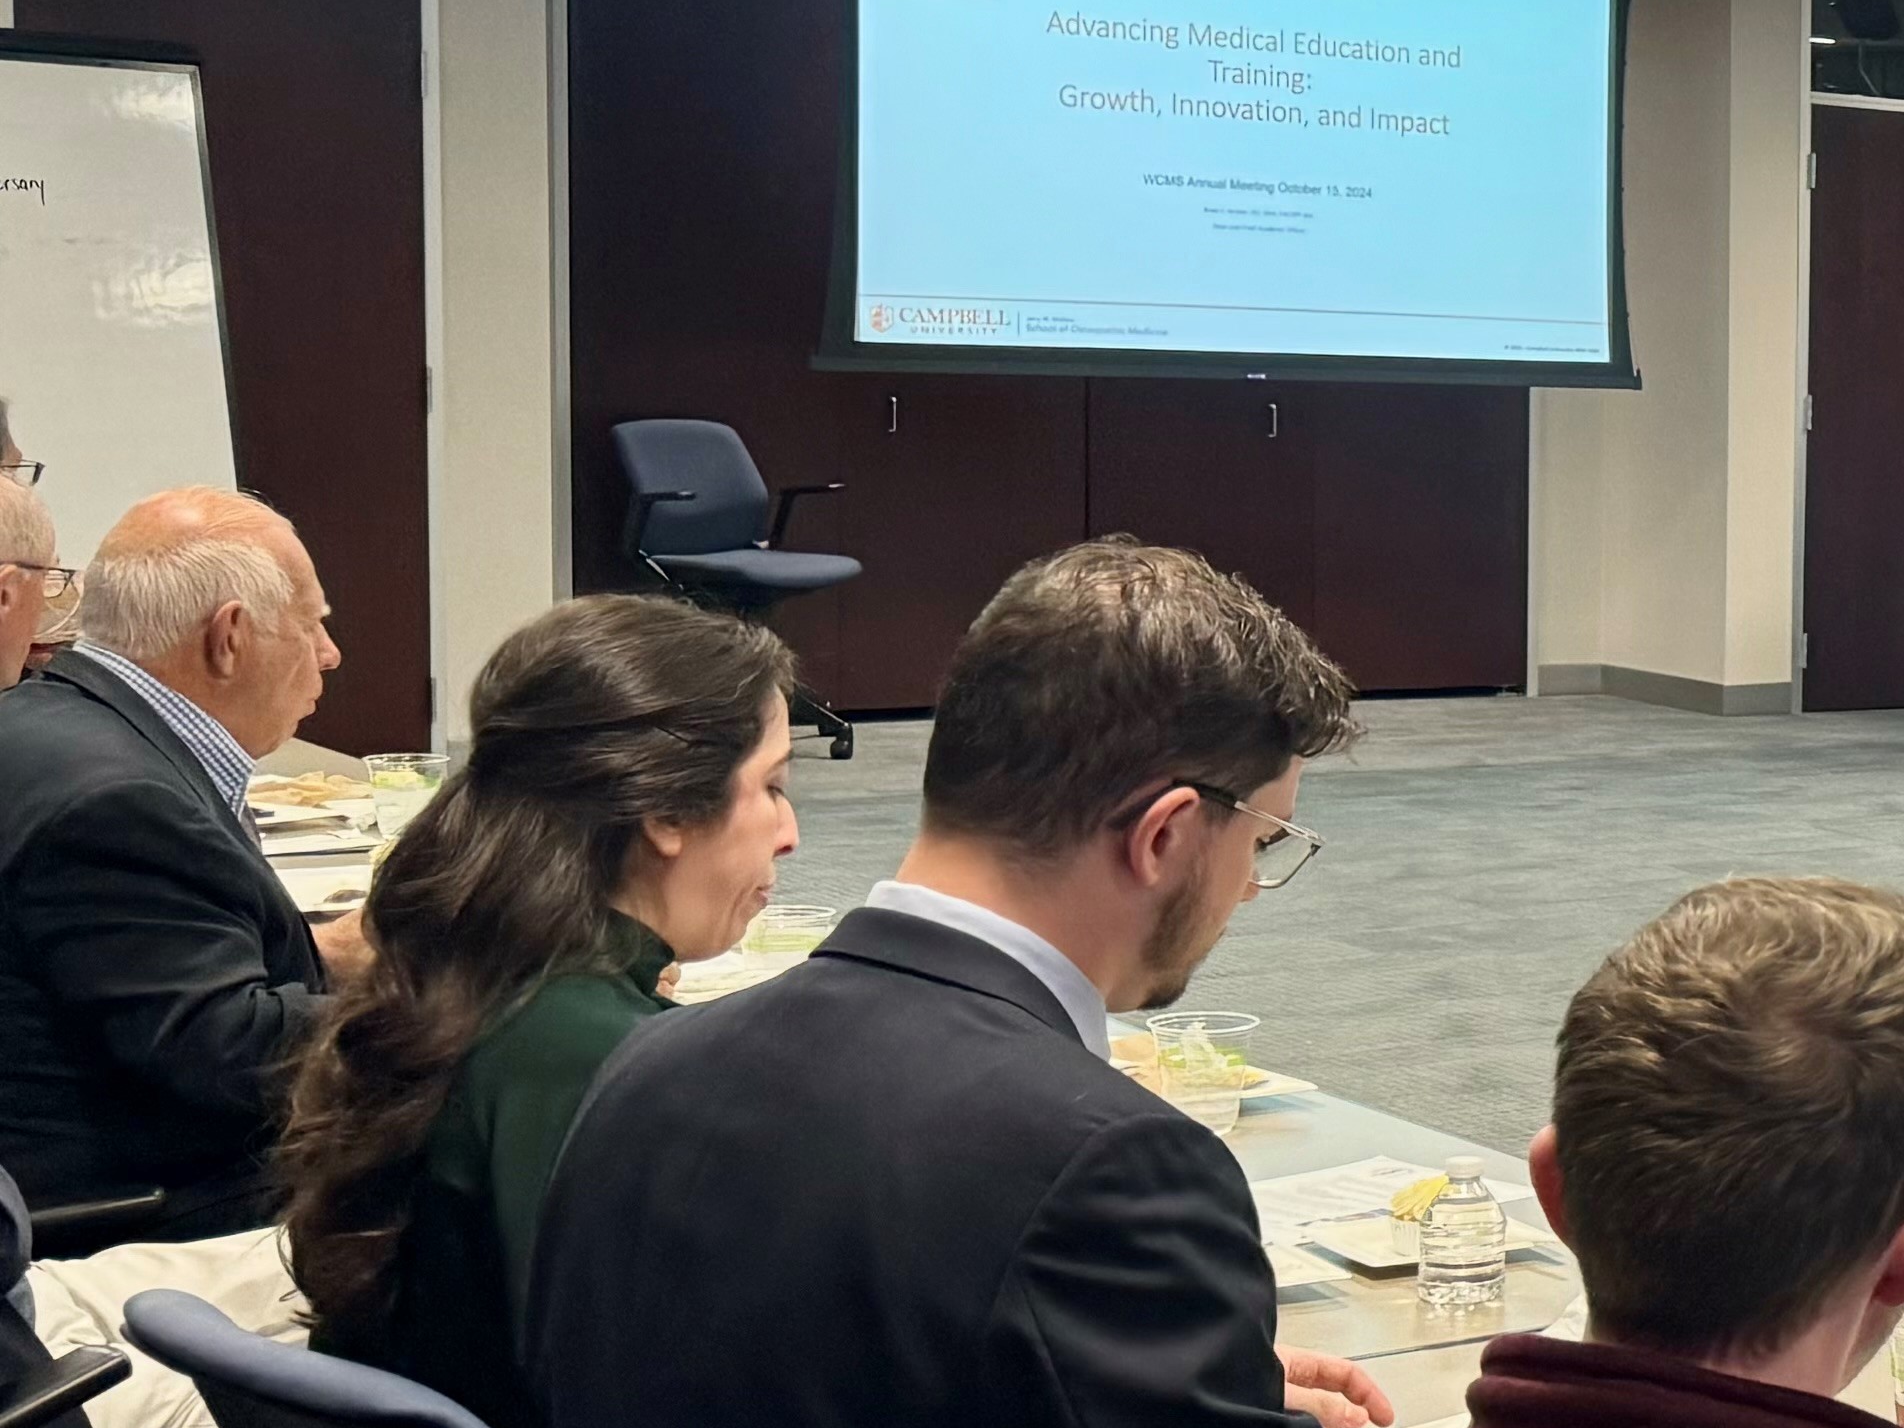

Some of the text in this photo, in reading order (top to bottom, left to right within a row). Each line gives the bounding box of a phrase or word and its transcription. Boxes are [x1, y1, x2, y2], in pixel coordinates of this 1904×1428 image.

[1046, 10, 1462, 68] Advancing Medical Education and
[1208, 59, 1313, 95] Training:
[1059, 83, 1450, 137] Growth, Innovation, and Impact
[1143, 174, 1184, 187] WCMS
[1187, 176, 1227, 190] Annual
[1229, 179, 1275, 195] Meeting
[1278, 181, 1322, 195] October
[1345, 186, 1373, 199] 2024
[899, 307, 1011, 326] CAMPBELL
